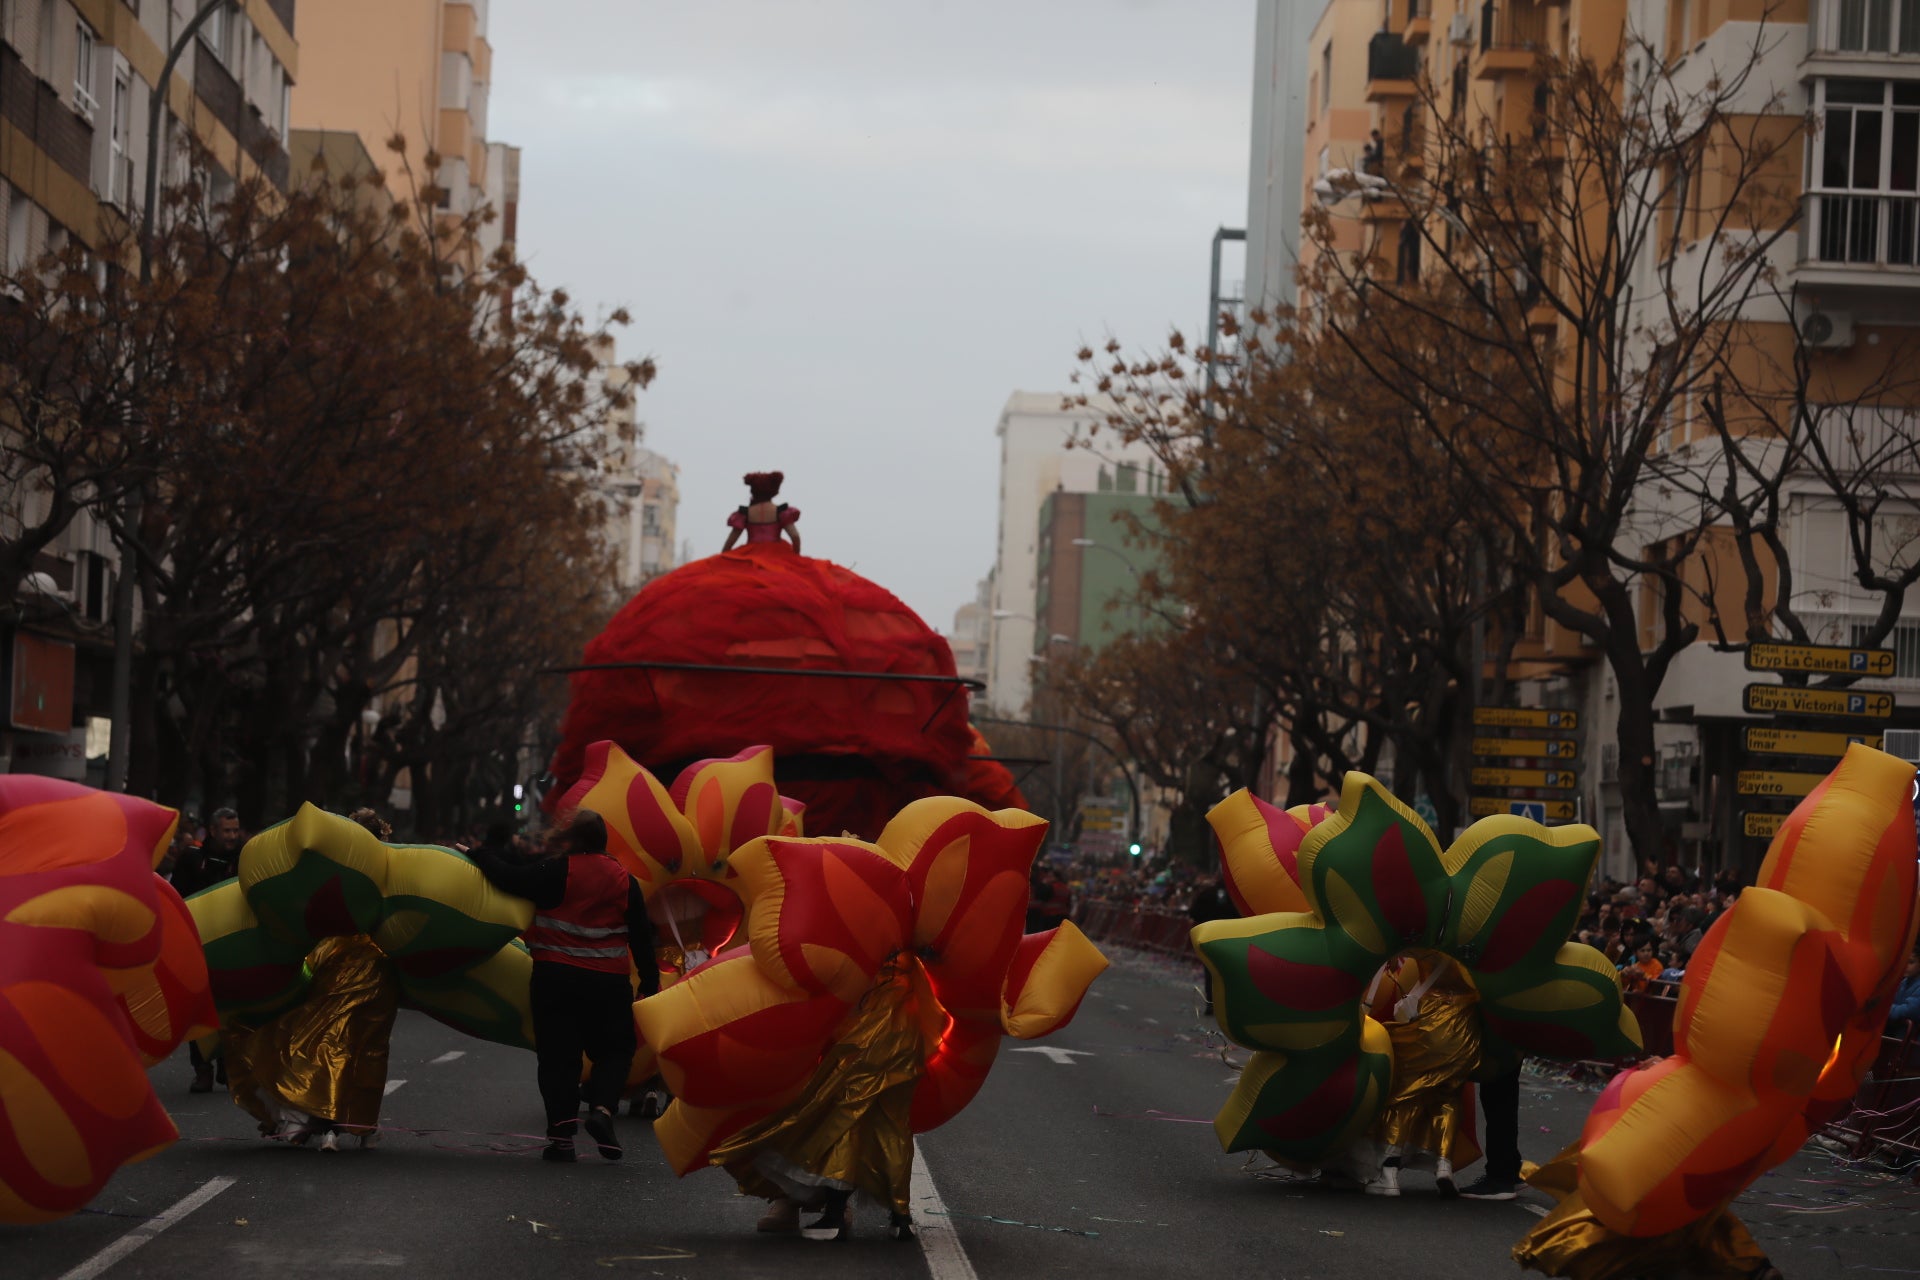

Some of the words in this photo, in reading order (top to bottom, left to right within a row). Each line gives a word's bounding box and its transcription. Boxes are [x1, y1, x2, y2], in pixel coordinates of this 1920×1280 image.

[1752, 644, 1779, 654] Hotel
[1752, 653, 1782, 668] Tryp
[1785, 656, 1799, 667] La
[1803, 656, 1847, 670] Caleta
[1751, 686, 1778, 697] Hotel
[1751, 696, 1787, 711] Playa
[1792, 698, 1844, 713] Victoria
[1750, 730, 1781, 739] Hostal
[1749, 739, 1777, 750] Imar
[1739, 781, 1784, 795] Playero
[1747, 815, 1773, 824] Hotel
[1747, 823, 1773, 836] Spa
